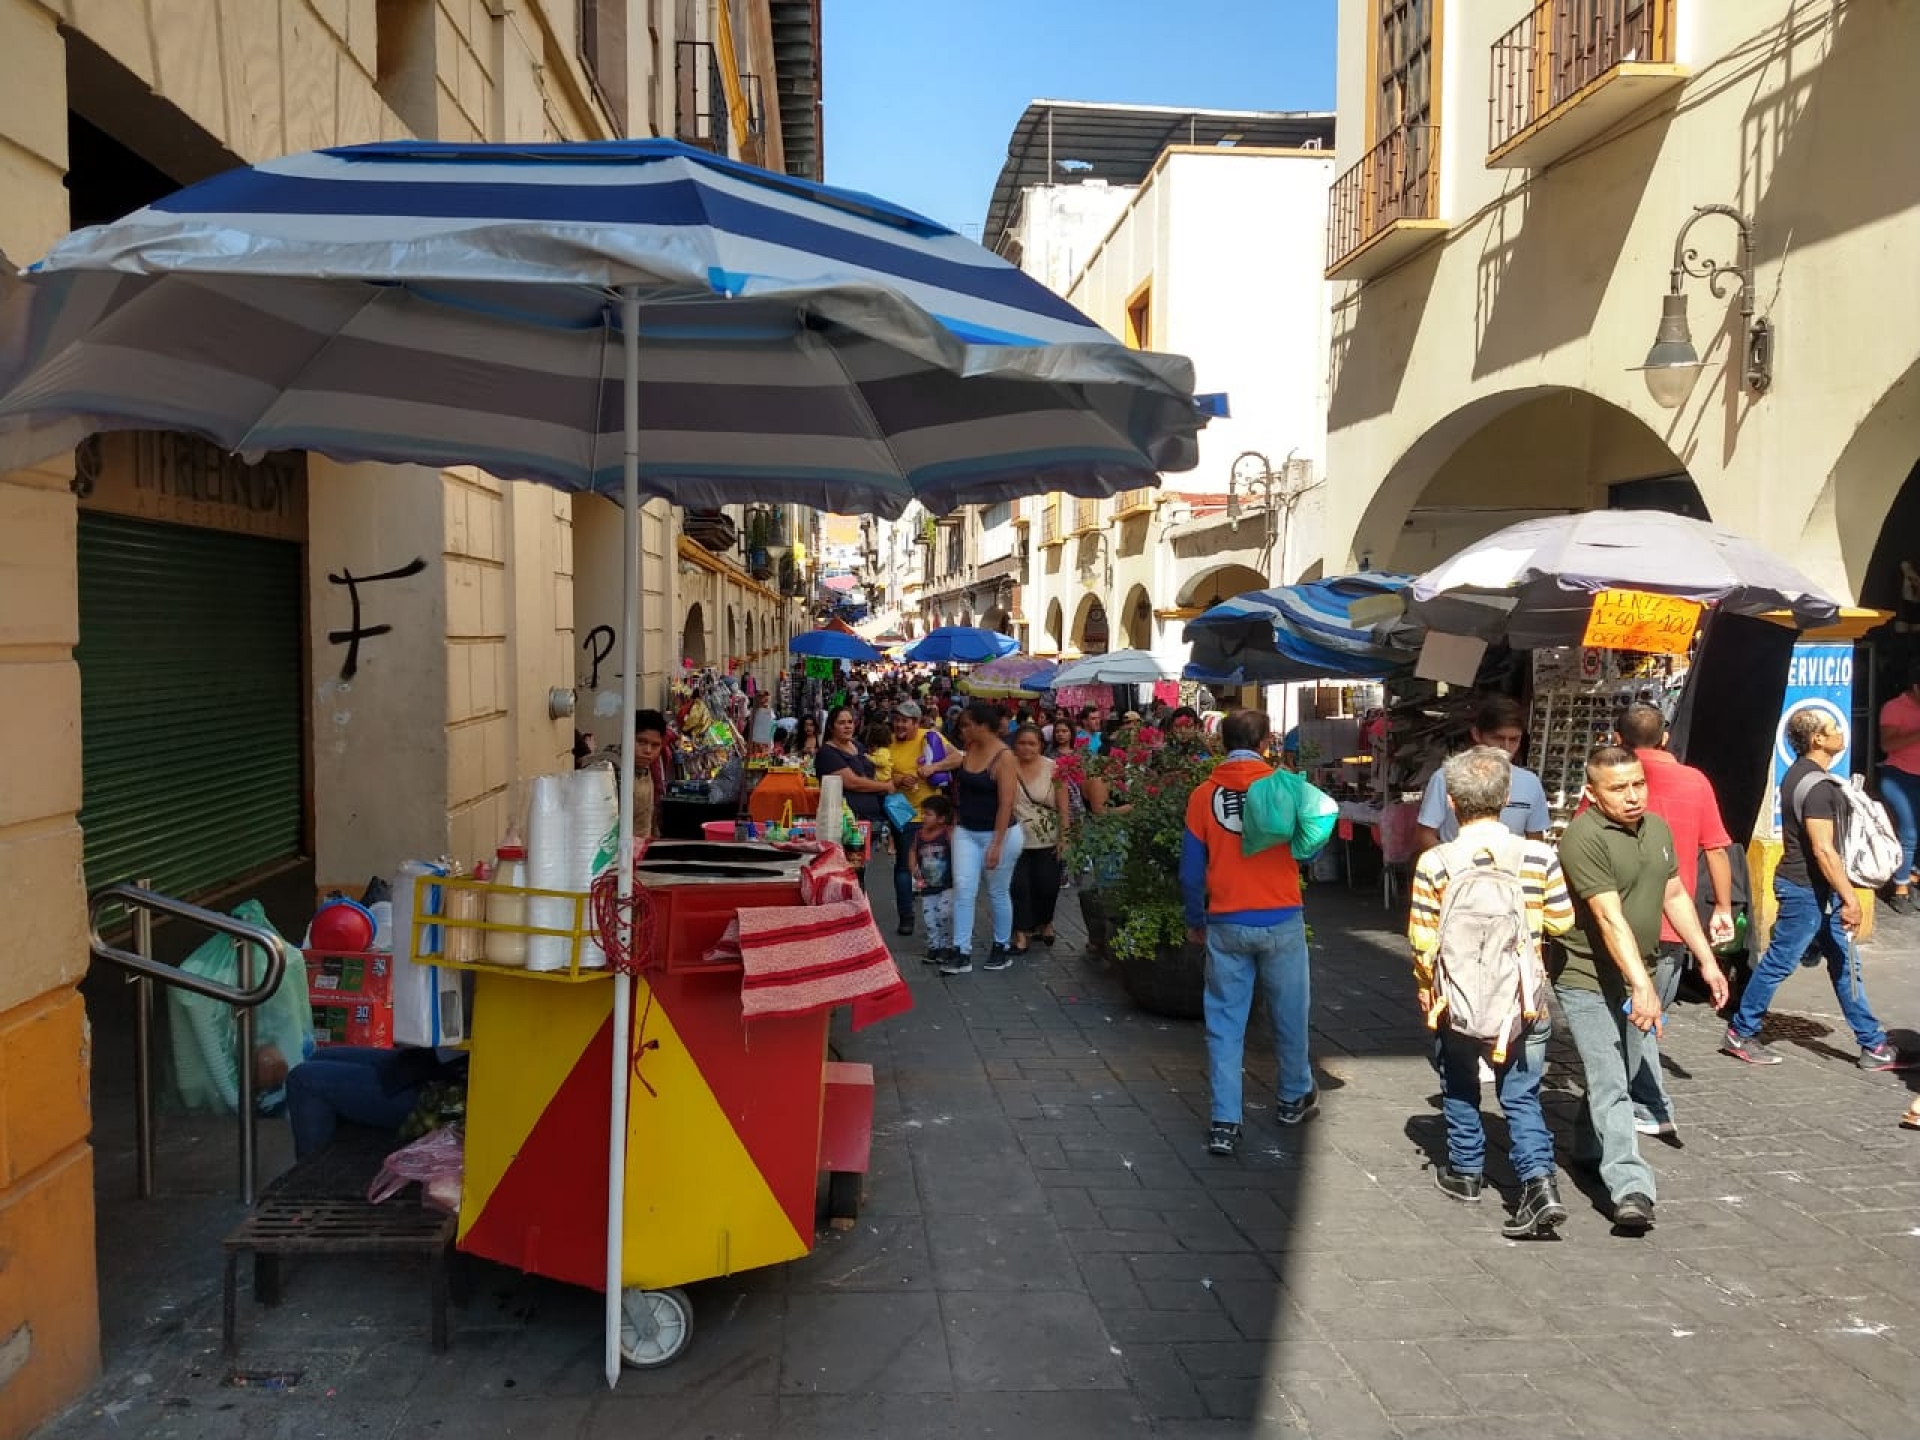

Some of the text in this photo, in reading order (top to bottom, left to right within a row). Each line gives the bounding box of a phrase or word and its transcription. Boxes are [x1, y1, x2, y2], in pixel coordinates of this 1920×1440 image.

[327, 557, 427, 680] F
[583, 625, 616, 688] P
[1788, 656, 1852, 686] ERVICIO
